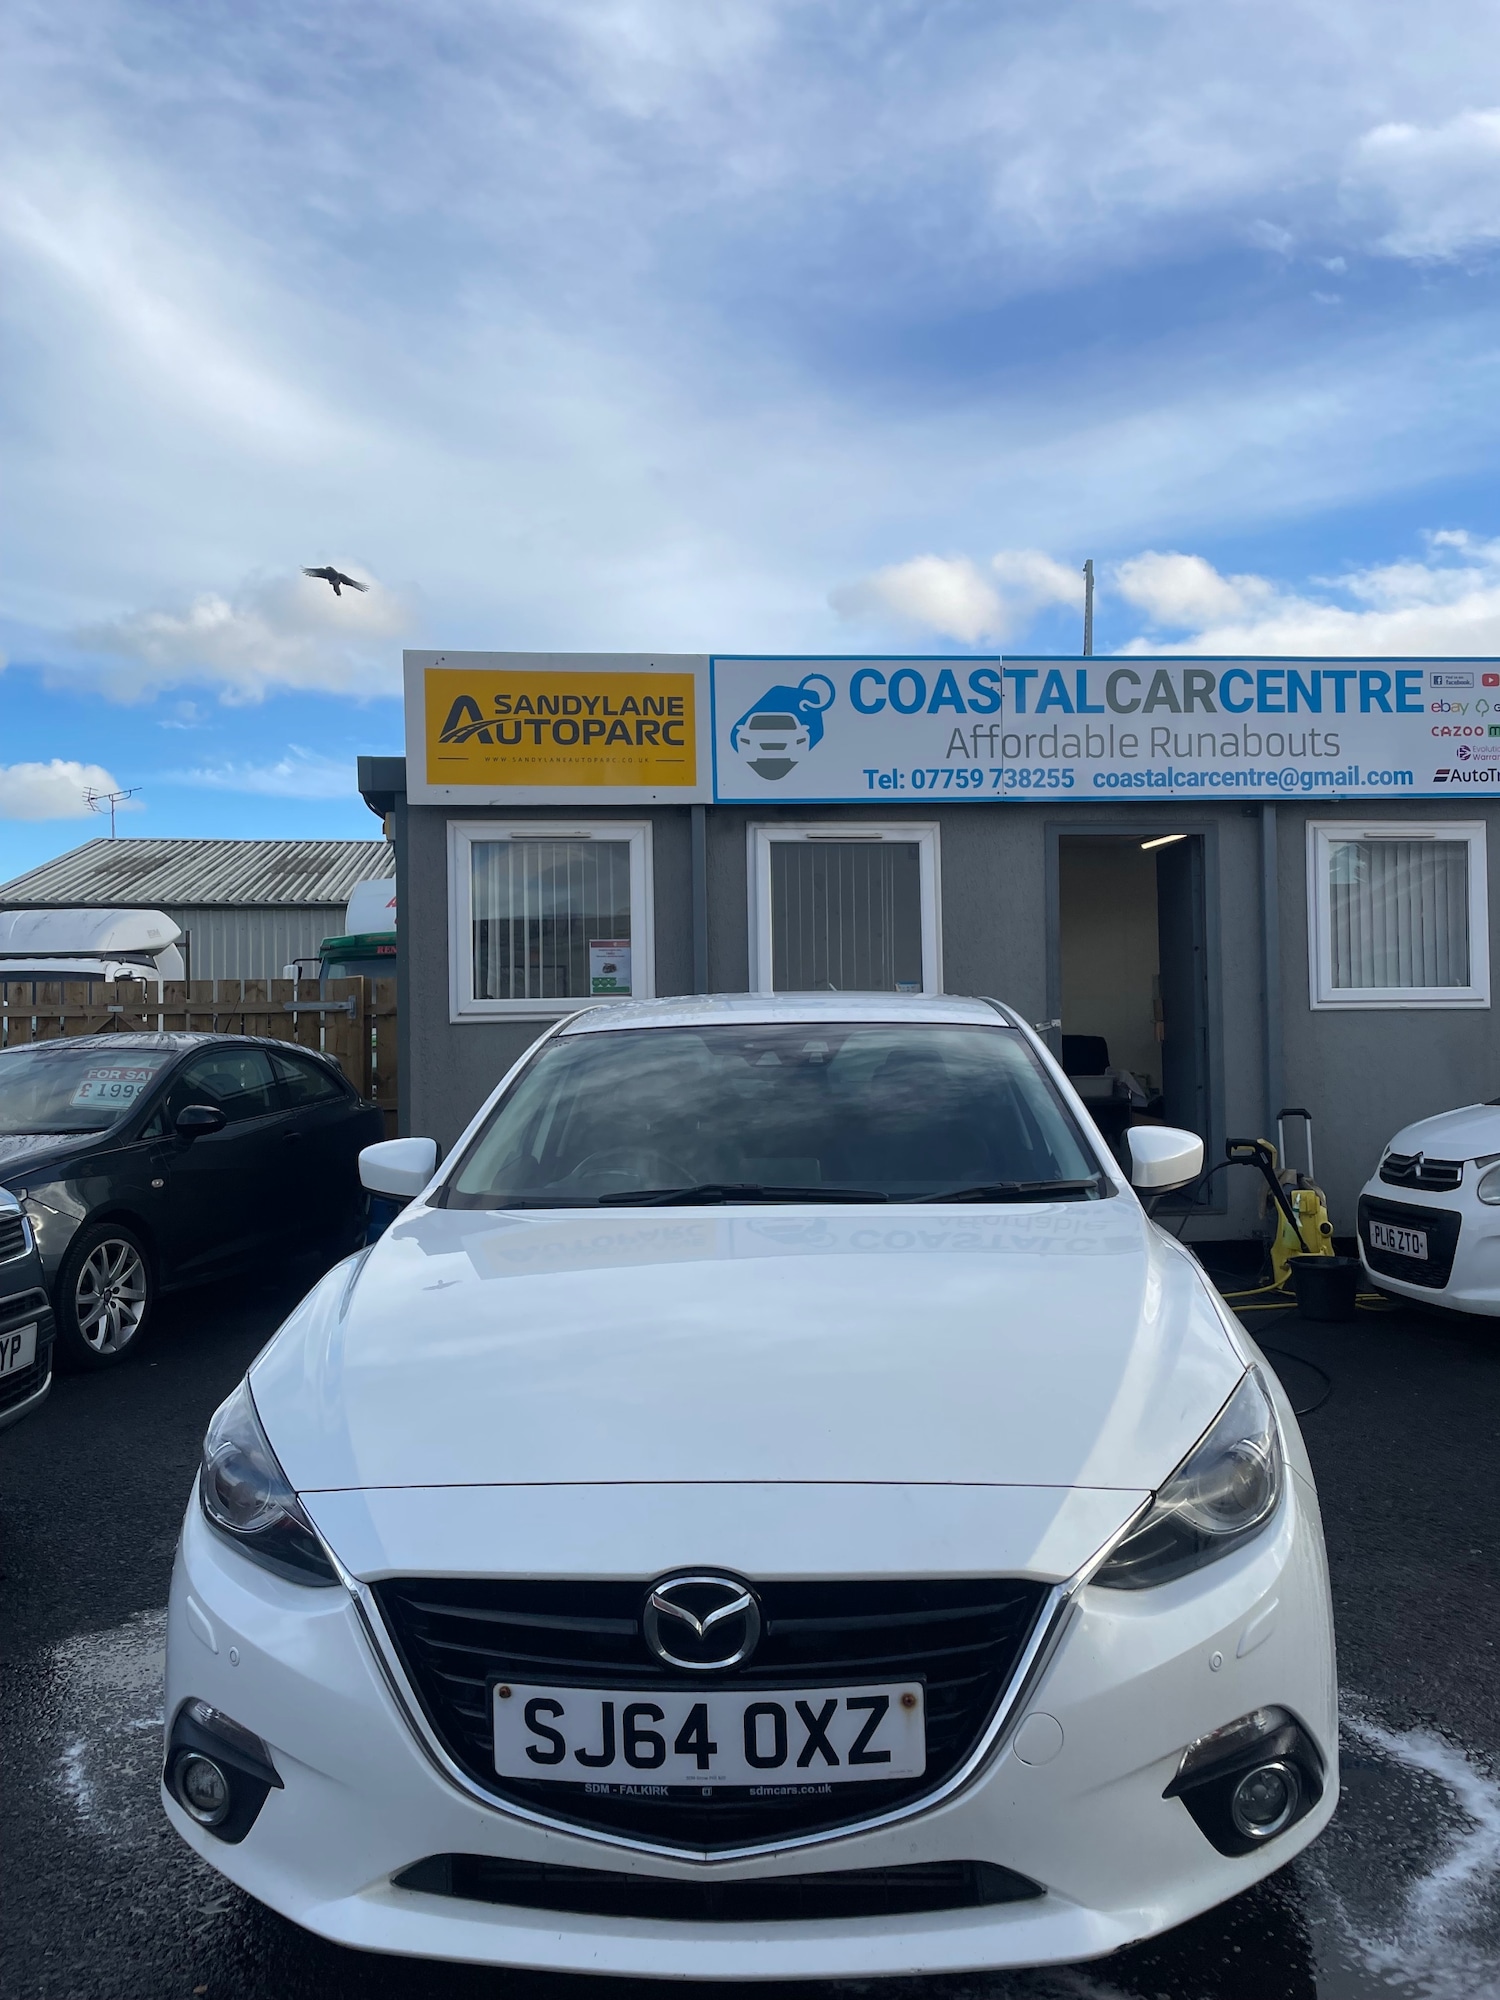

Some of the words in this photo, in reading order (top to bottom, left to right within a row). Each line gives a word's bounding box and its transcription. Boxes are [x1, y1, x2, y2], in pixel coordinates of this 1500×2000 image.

[494, 694, 684, 716] SANDYLANE
[1431, 699, 1469, 716] ebay
[438, 695, 685, 746] AUTOPARC
[946, 723, 1139, 759] Affordable
[1151, 723, 1341, 758] Runabouts
[863, 769, 905, 789] Tel:
[911, 769, 983, 790] 07759
[989, 769, 1075, 789] 738255
[1093, 766, 1414, 791] coastalcarcentre@gmail.com
[87, 1069, 121, 1079] FOR
[1374, 1225, 1396, 1248] PL16
[1397, 1231, 1420, 1254] ZTO
[523, 1697, 718, 1770] SJ64
[743, 1695, 892, 1769] OXZ
[584, 1783, 610, 1794] SDM
[619, 1785, 669, 1796] FALKIRK
[749, 1783, 832, 1796] sdmcars.co.uk
